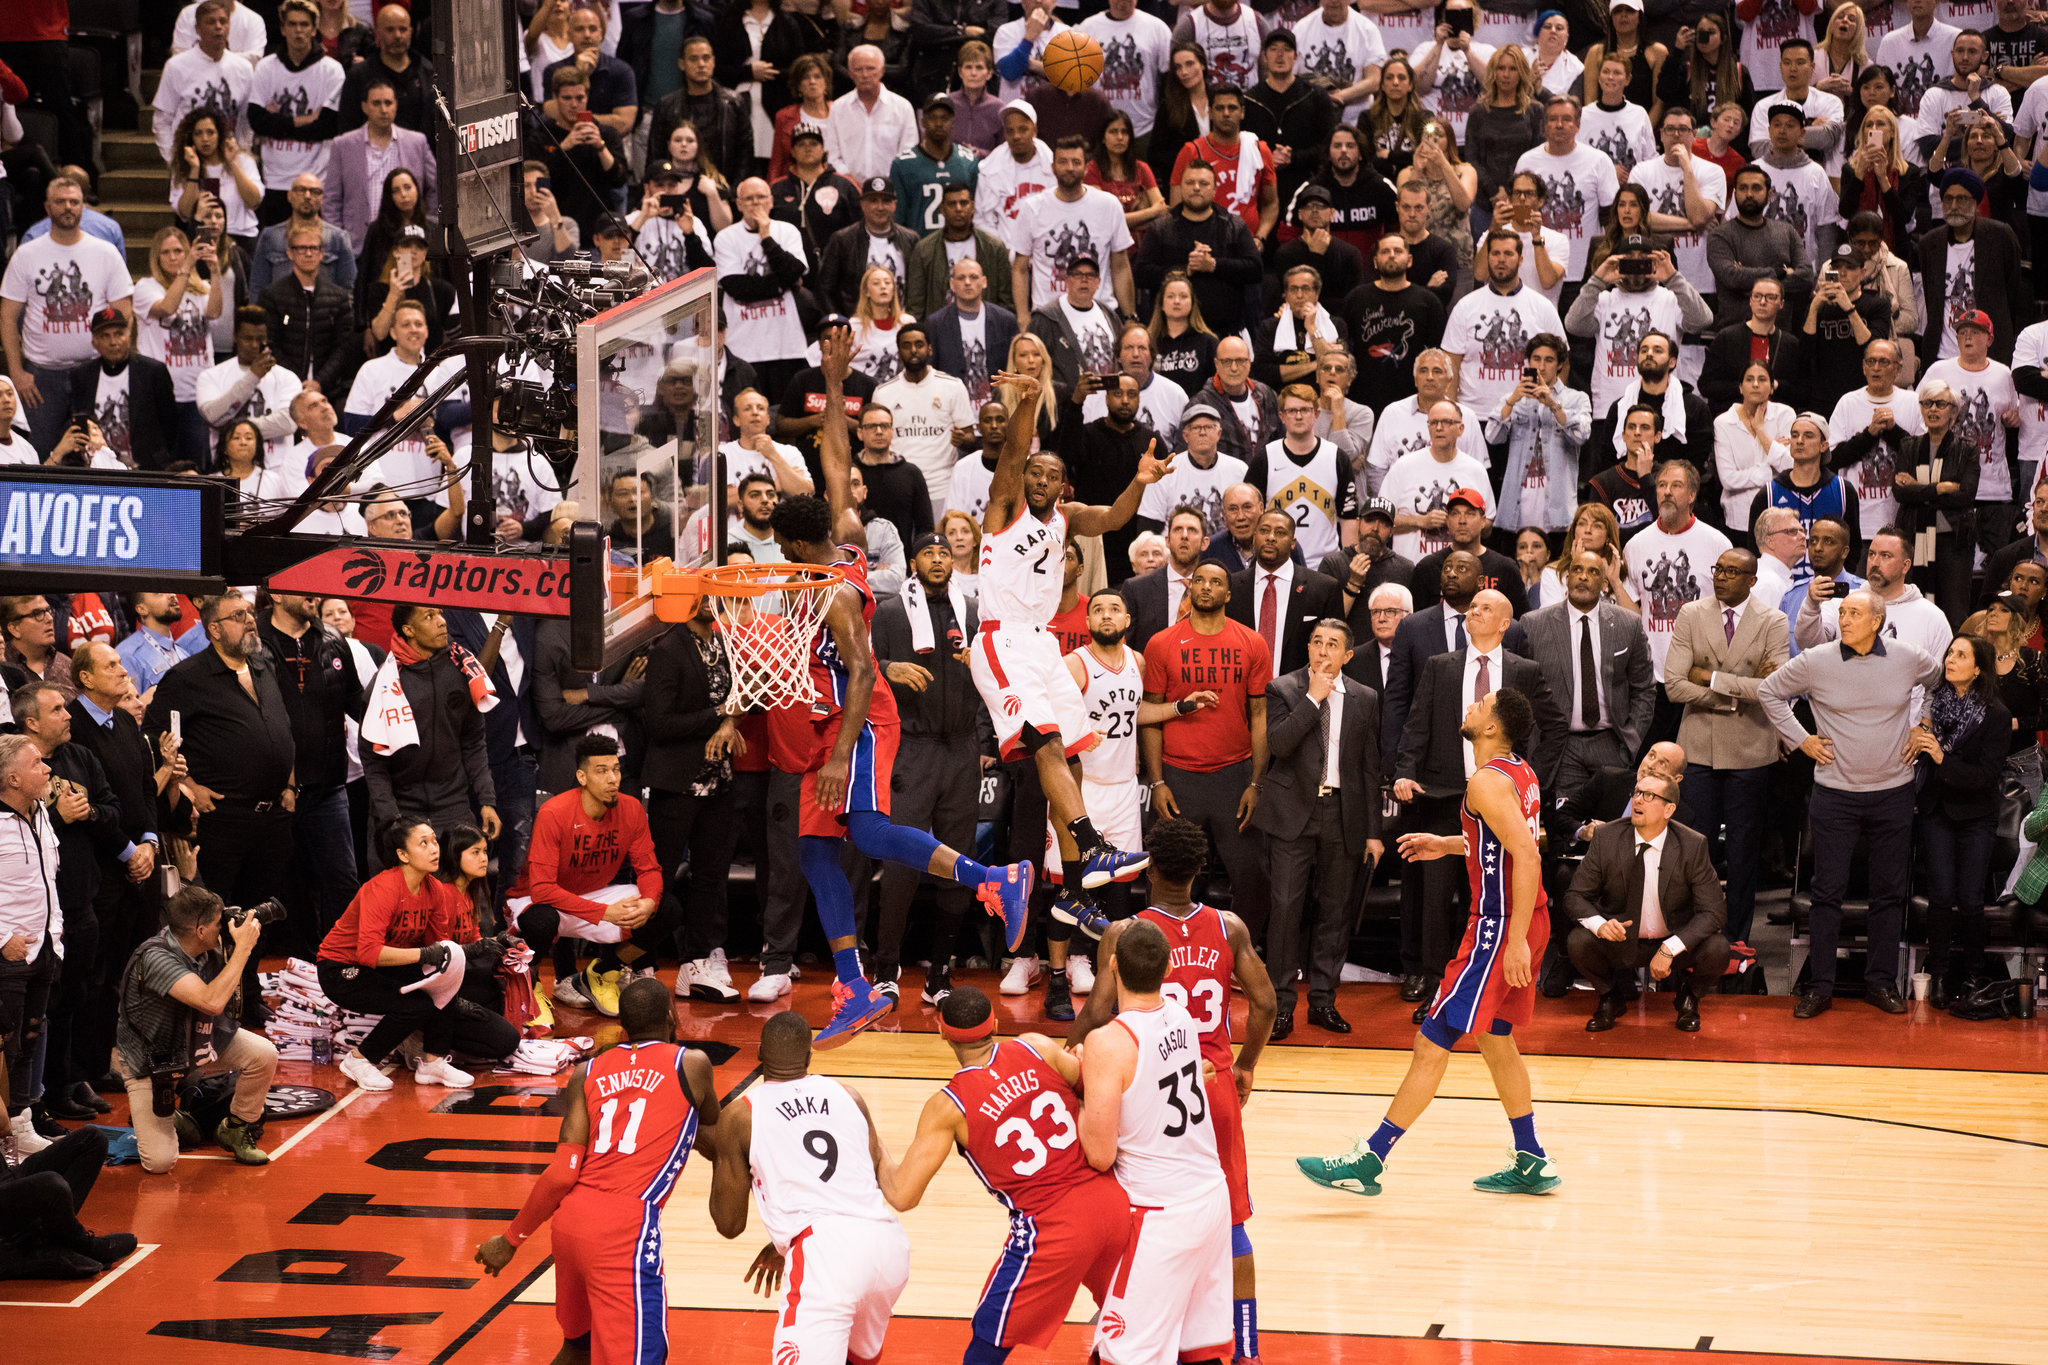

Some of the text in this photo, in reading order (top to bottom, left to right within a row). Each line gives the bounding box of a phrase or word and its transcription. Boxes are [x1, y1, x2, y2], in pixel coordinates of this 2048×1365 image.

[1990, 40, 2036, 55] WE THE
[475, 112, 518, 149] TISSOT
[741, 305, 787, 320] NORTH
[43, 321, 93, 334] NORTH
[896, 425, 945, 438] Emirates
[911, 415, 927, 426] Fly
[1274, 483, 1331, 511] NORTH
[1, 491, 142, 559] AYOFFS
[1296, 504, 1310, 528] 2
[1033, 547, 1050, 575] 2
[1056, 632, 1089, 649] THE
[1181, 648, 1241, 664] WE THE
[1181, 666, 1243, 684] NORTH
[1106, 711, 1135, 740] 23
[573, 830, 620, 853] WE THE
[568, 847, 620, 869] NORTH
[1159, 1027, 1189, 1062] GASOL
[596, 1069, 645, 1097] ENNIS
[978, 1068, 1041, 1122] HARRIS
[776, 1096, 830, 1121] IBAKA
[1158, 1059, 1207, 1137] 33
[594, 1098, 647, 1154] 11
[994, 1090, 1079, 1177] 33
[802, 1129, 839, 1183] 9
